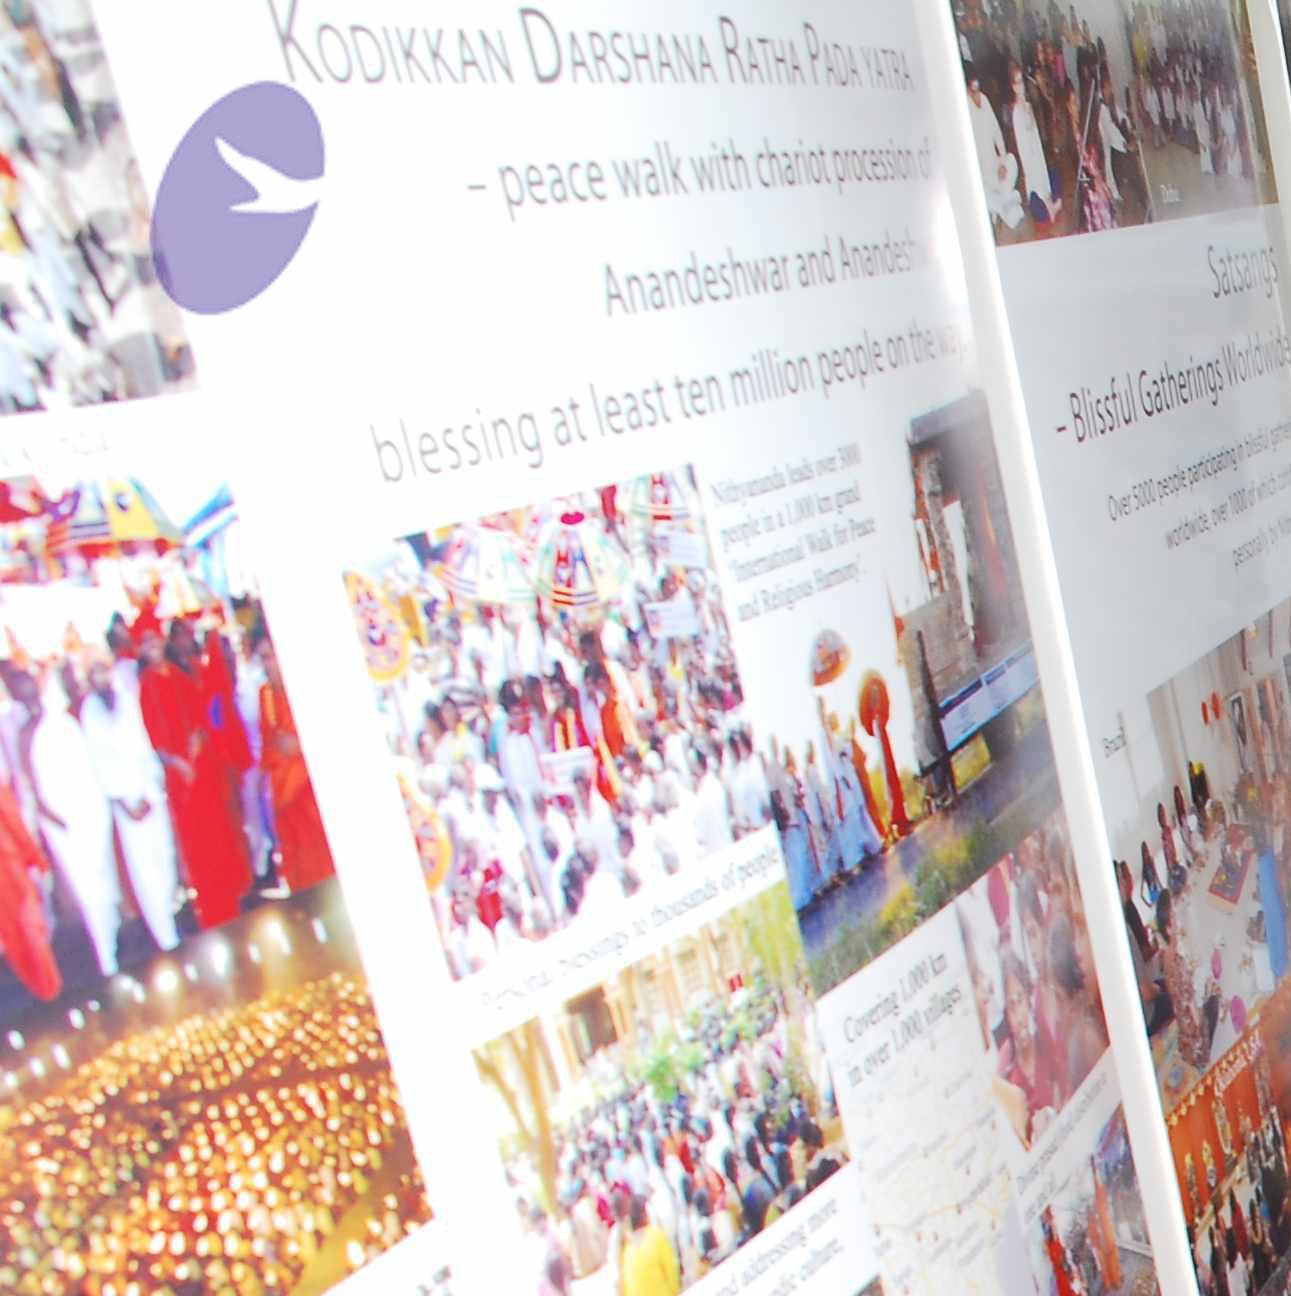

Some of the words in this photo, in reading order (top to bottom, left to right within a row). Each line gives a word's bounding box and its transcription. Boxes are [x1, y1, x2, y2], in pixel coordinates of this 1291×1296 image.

[498, 160, 608, 221] peace
[612, 141, 688, 198] walk
[690, 139, 752, 192] with
[756, 139, 831, 188] chariot
[832, 139, 913, 194] procession
[605, 248, 790, 316] Anandeshwar
[796, 236, 836, 288] and
[1207, 245, 1279, 299] Satsangs
[370, 413, 544, 482] blessing
[551, 398, 587, 446] at
[590, 380, 672, 436] least
[674, 375, 726, 419] ten
[728, 349, 814, 406] million
[816, 328, 885, 400] people
[886, 329, 907, 369] on
[1070, 373, 1138, 443] Blissful
[1138, 355, 1224, 417] Gatherings
[1223, 330, 1291, 386] Worldwide
